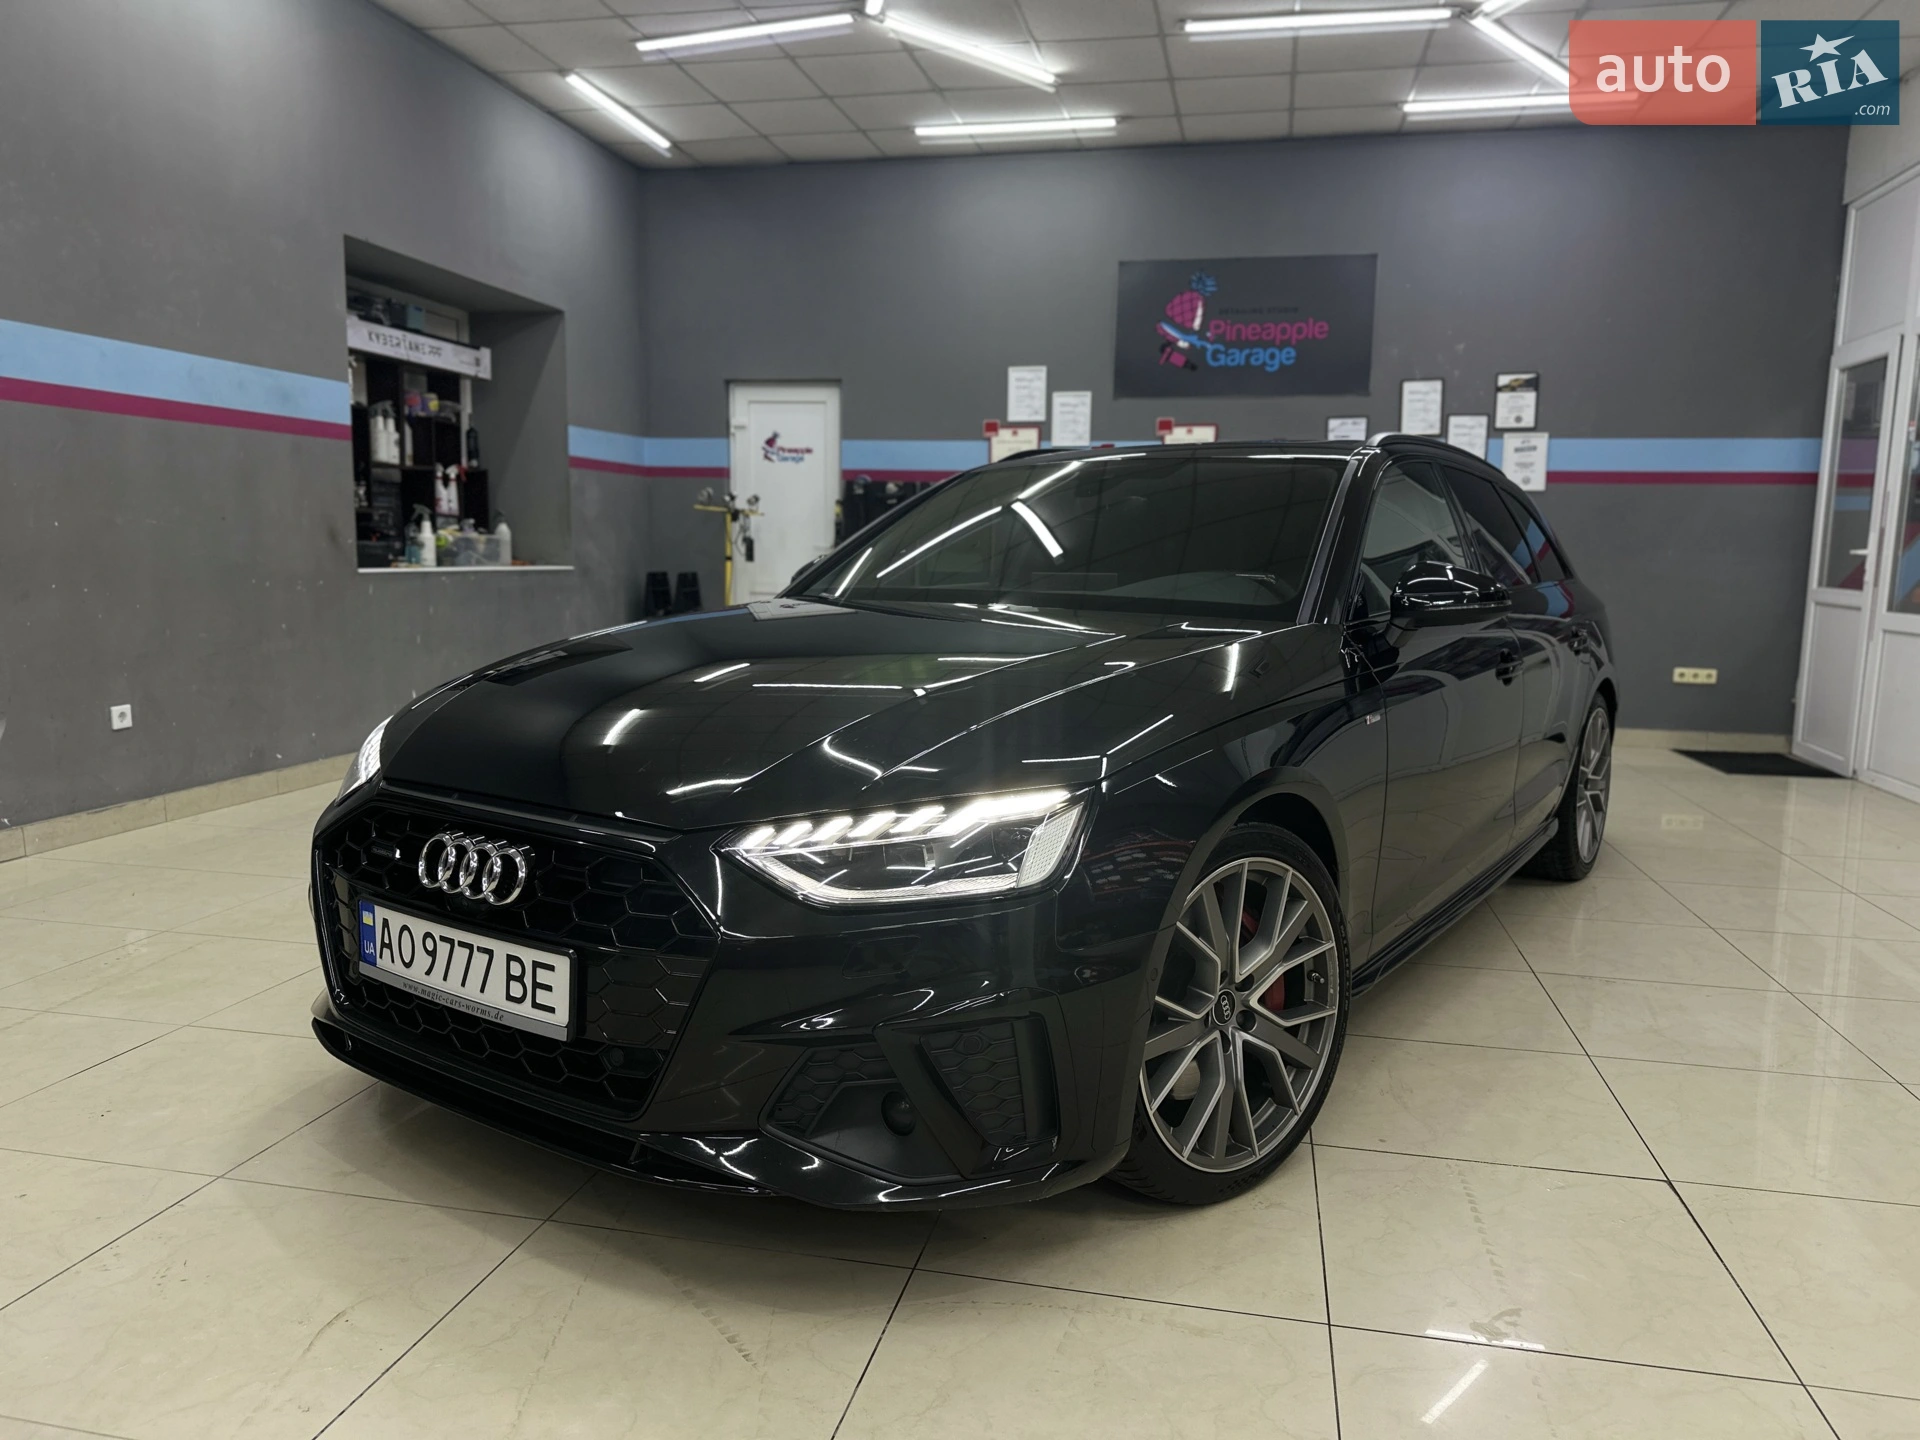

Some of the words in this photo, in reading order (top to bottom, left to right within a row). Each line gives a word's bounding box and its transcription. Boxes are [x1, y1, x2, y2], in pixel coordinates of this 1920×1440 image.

[1209, 316, 1330, 346] Pineapple
[1206, 343, 1297, 372] Garage
[364, 940, 375, 955] UA
[379, 917, 416, 969] AO
[422, 931, 495, 994] 9777
[505, 953, 556, 1014] BE
[402, 981, 505, 1021] www.magic-cars-worms.de
